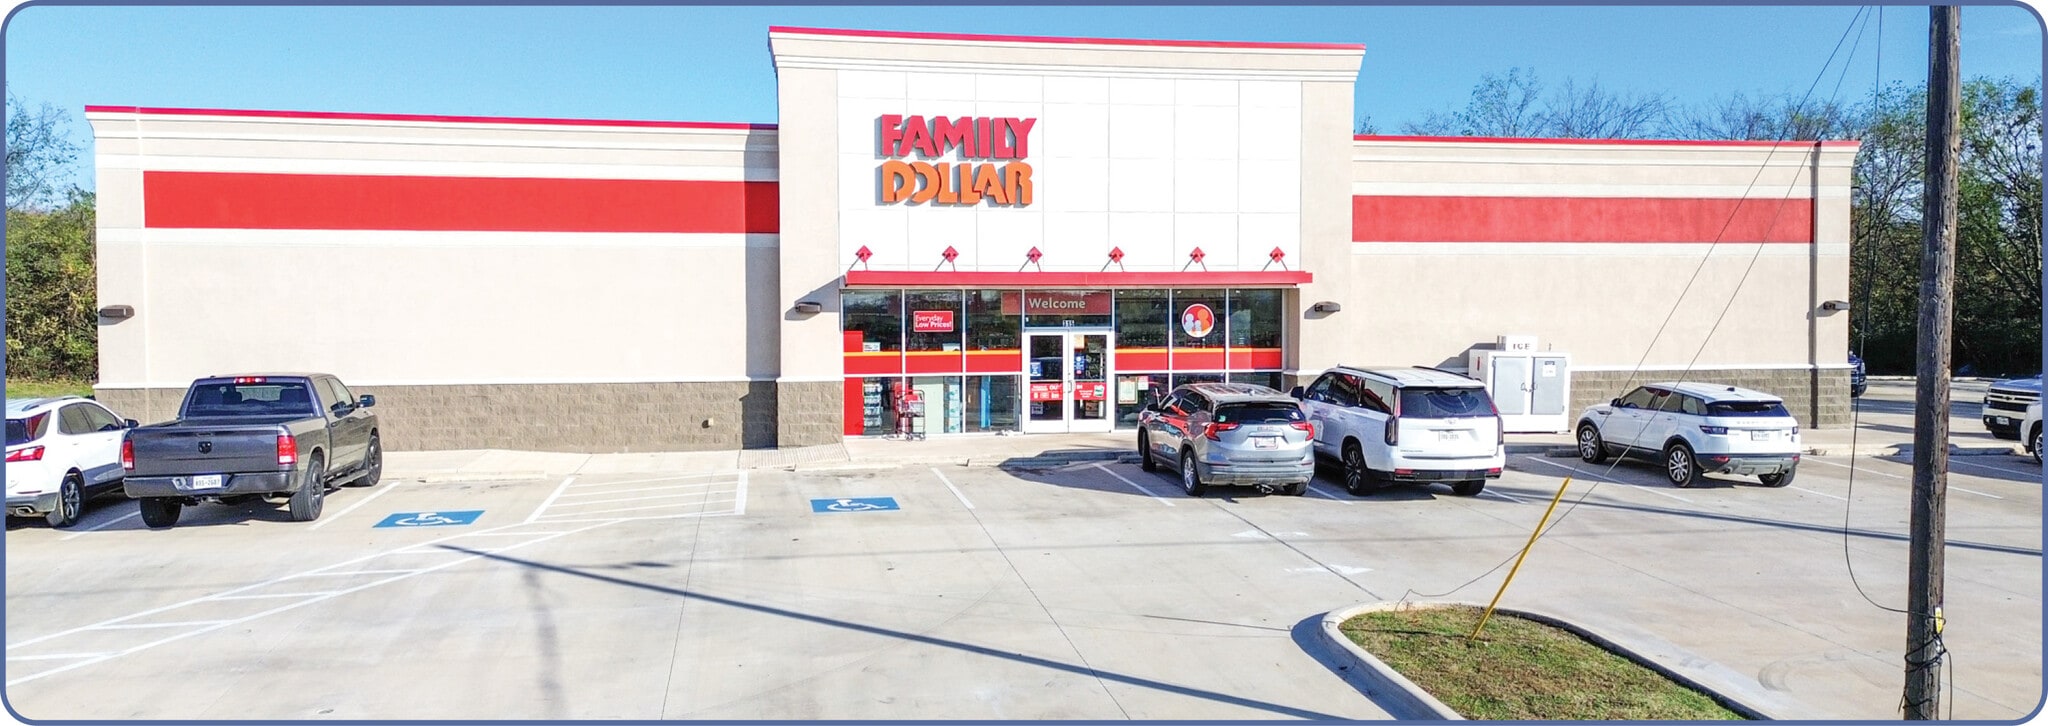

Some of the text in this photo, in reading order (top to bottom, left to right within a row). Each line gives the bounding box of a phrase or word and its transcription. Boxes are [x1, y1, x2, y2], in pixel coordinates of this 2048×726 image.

[875, 114, 1037, 160] FAMILY
[877, 160, 1034, 207] DOLLAR
[1028, 297, 1086, 309] Welcome
[915, 314, 944, 323] Everyday
